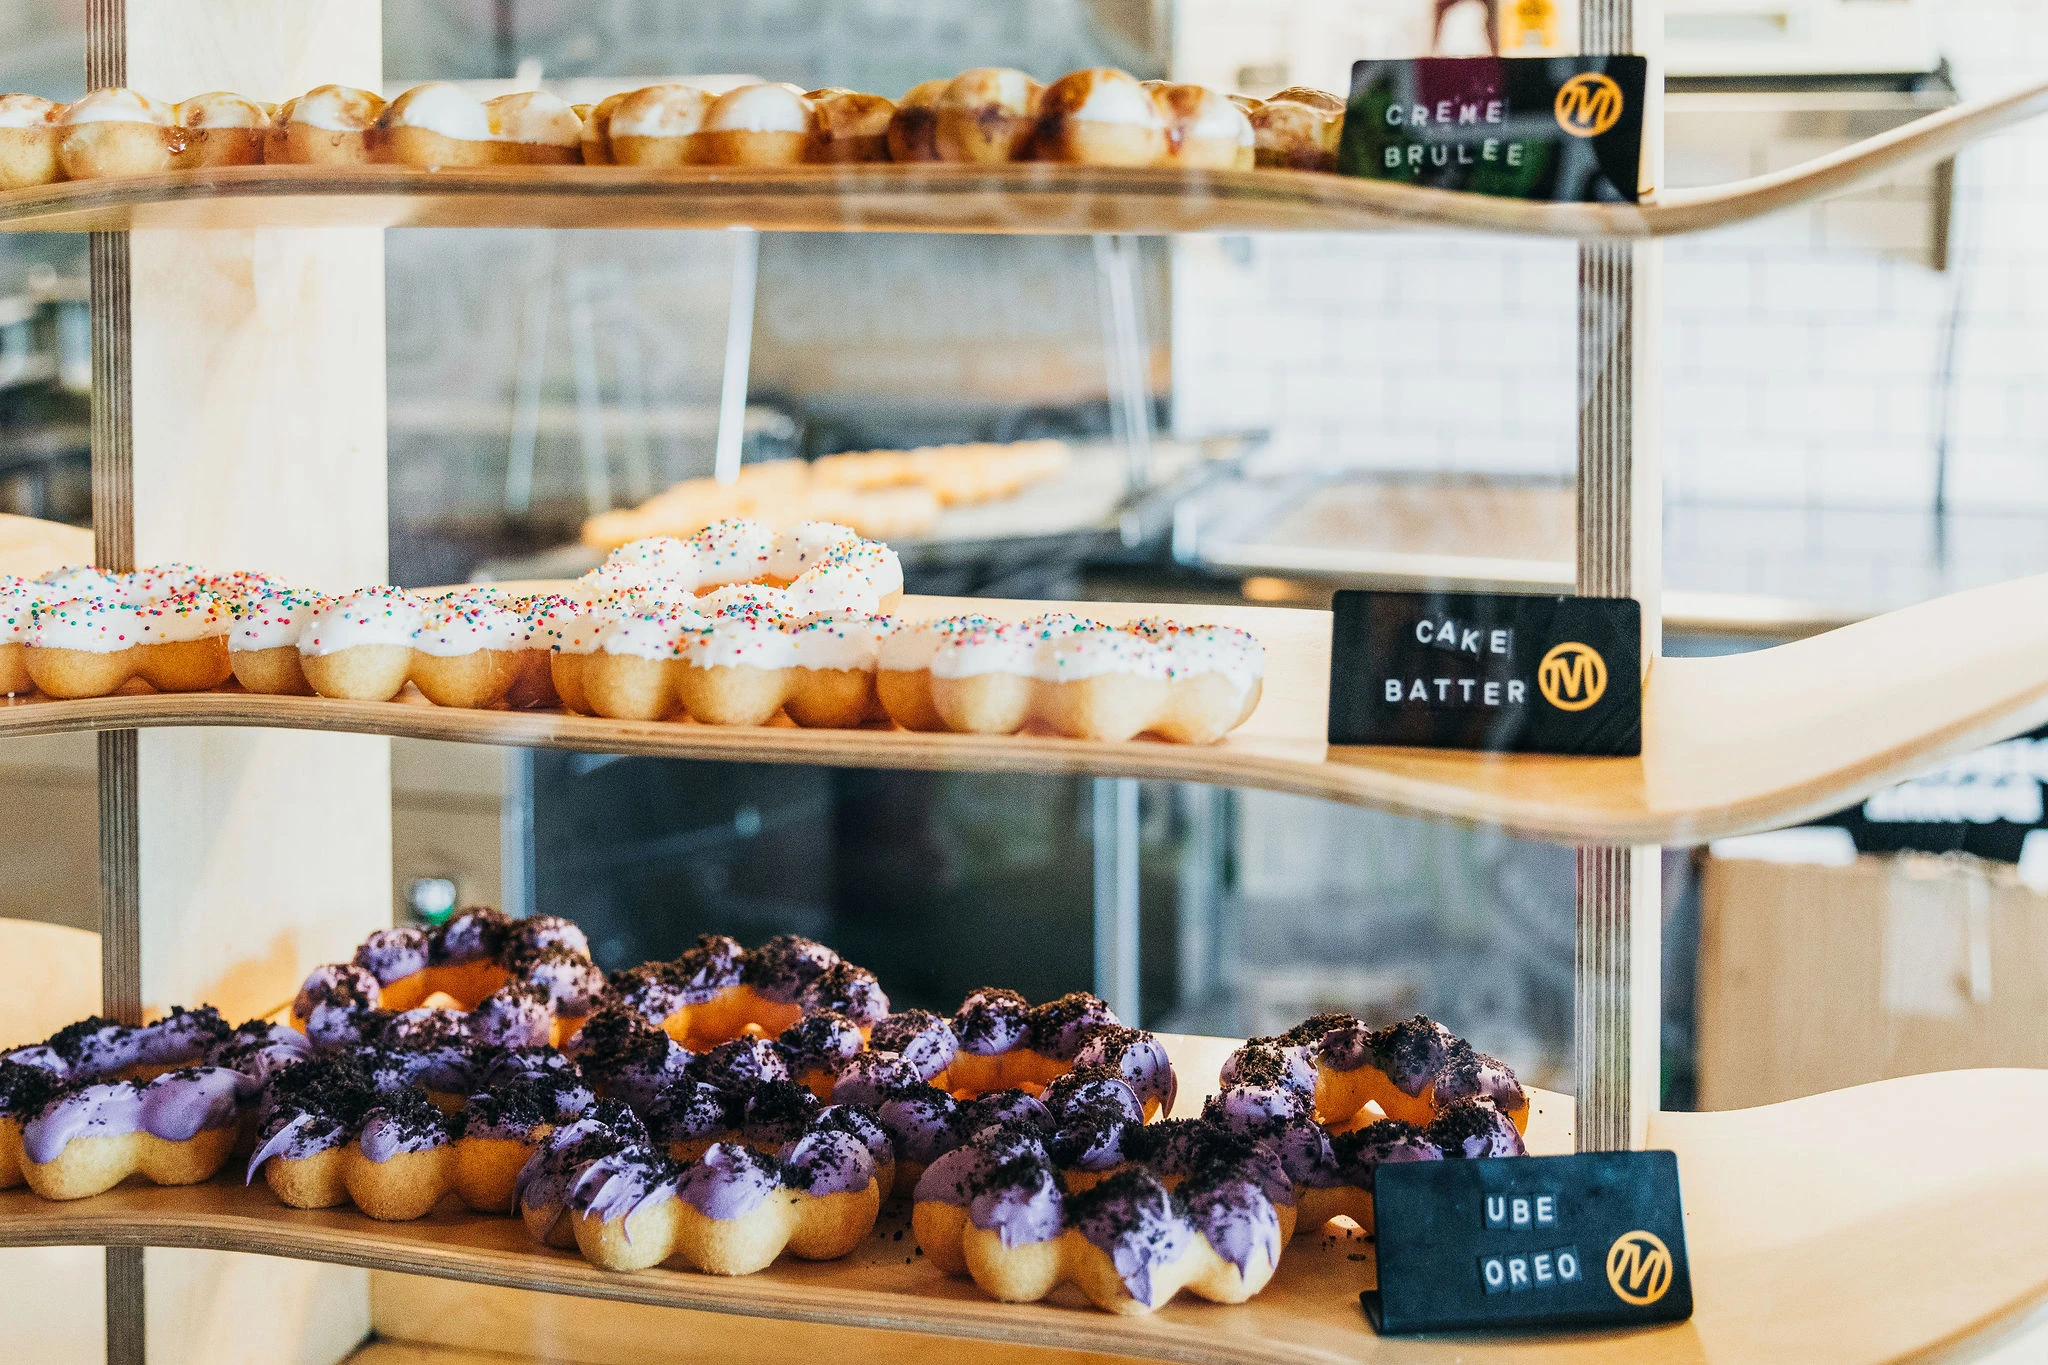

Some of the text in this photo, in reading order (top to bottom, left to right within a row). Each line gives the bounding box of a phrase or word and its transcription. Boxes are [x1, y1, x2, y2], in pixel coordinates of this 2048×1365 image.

[1386, 100, 1502, 126] CREME
[1384, 138, 1524, 168] BRULEE
[1415, 619, 1508, 653] CAKE
[1385, 678, 1525, 706] BATTER
[1487, 1196, 1554, 1224] UBE
[1485, 1253, 1577, 1286] OREO
